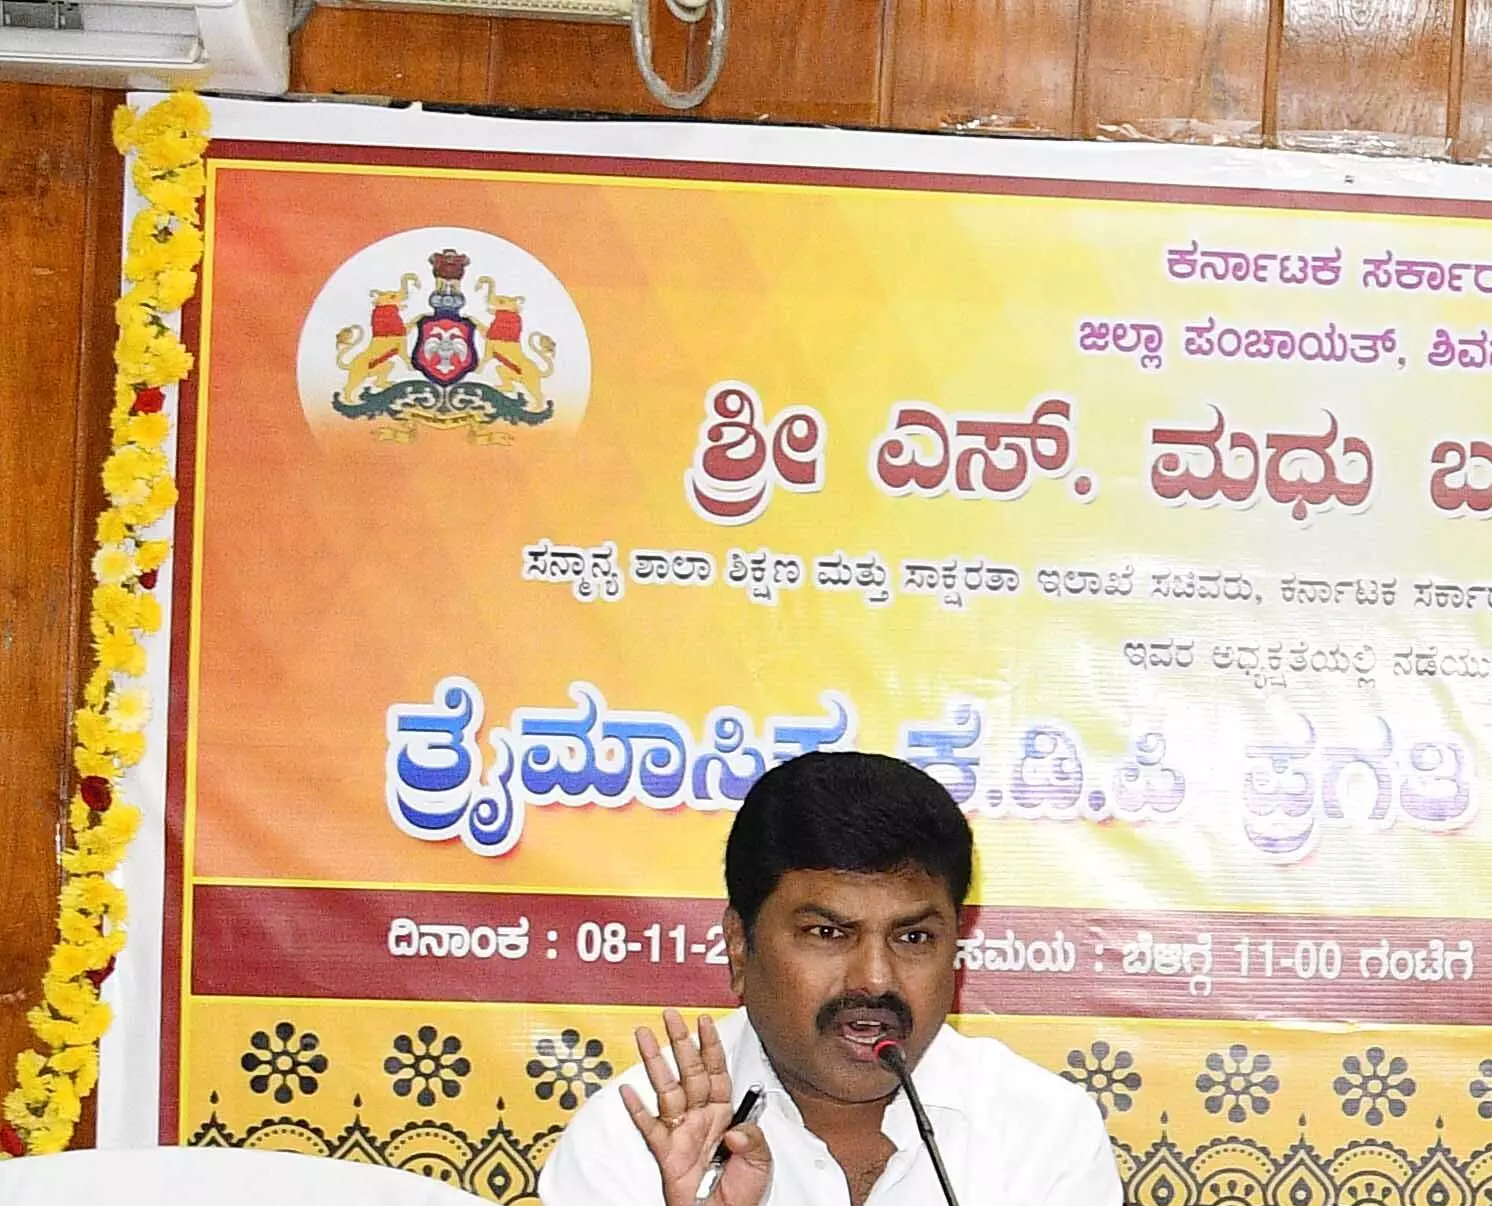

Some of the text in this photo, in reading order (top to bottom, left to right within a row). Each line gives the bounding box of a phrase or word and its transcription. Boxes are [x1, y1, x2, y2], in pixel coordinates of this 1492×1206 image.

[1166, 239, 1342, 287] ಕರ್ನಾಟಕ
[1079, 316, 1164, 370] ಜಿಲ್ಲಾ
[1184, 316, 1406, 371] ಪಂಚಾಯತ್,
[690, 386, 821, 519] ಶ್ರೀ
[875, 398, 1094, 500] ಎಸ್.
[1150, 403, 1375, 523] ಮಧು
[525, 544, 621, 597] ಸನ್ಮಾನ್ಯ
[634, 550, 711, 583] ಶಾಲಾ
[727, 552, 801, 600] ಶಿಕ್ಷಣ
[818, 552, 889, 602] ಮತ್ತು
[904, 558, 1020, 606] ಸಾಕ್ಷರತಾ
[1037, 565, 1135, 597] ಇಲಾಖೆ
[1151, 568, 1263, 605] ಸಚಿವರು,
[1280, 573, 1398, 607] ಕರ್ನಾಟಕ
[1123, 638, 1194, 671] ಇವರ
[1243, 708, 1473, 856] ಪ್ರಗತಿ
[387, 916, 530, 959] ದಿನಾಂಕ
[576, 921, 730, 965] 08-11-2
[953, 929, 1076, 972] ಸಮಯ
[1234, 936, 1342, 978] 11-00
[1359, 939, 1475, 982] ಗಂಟೆಗೆ
